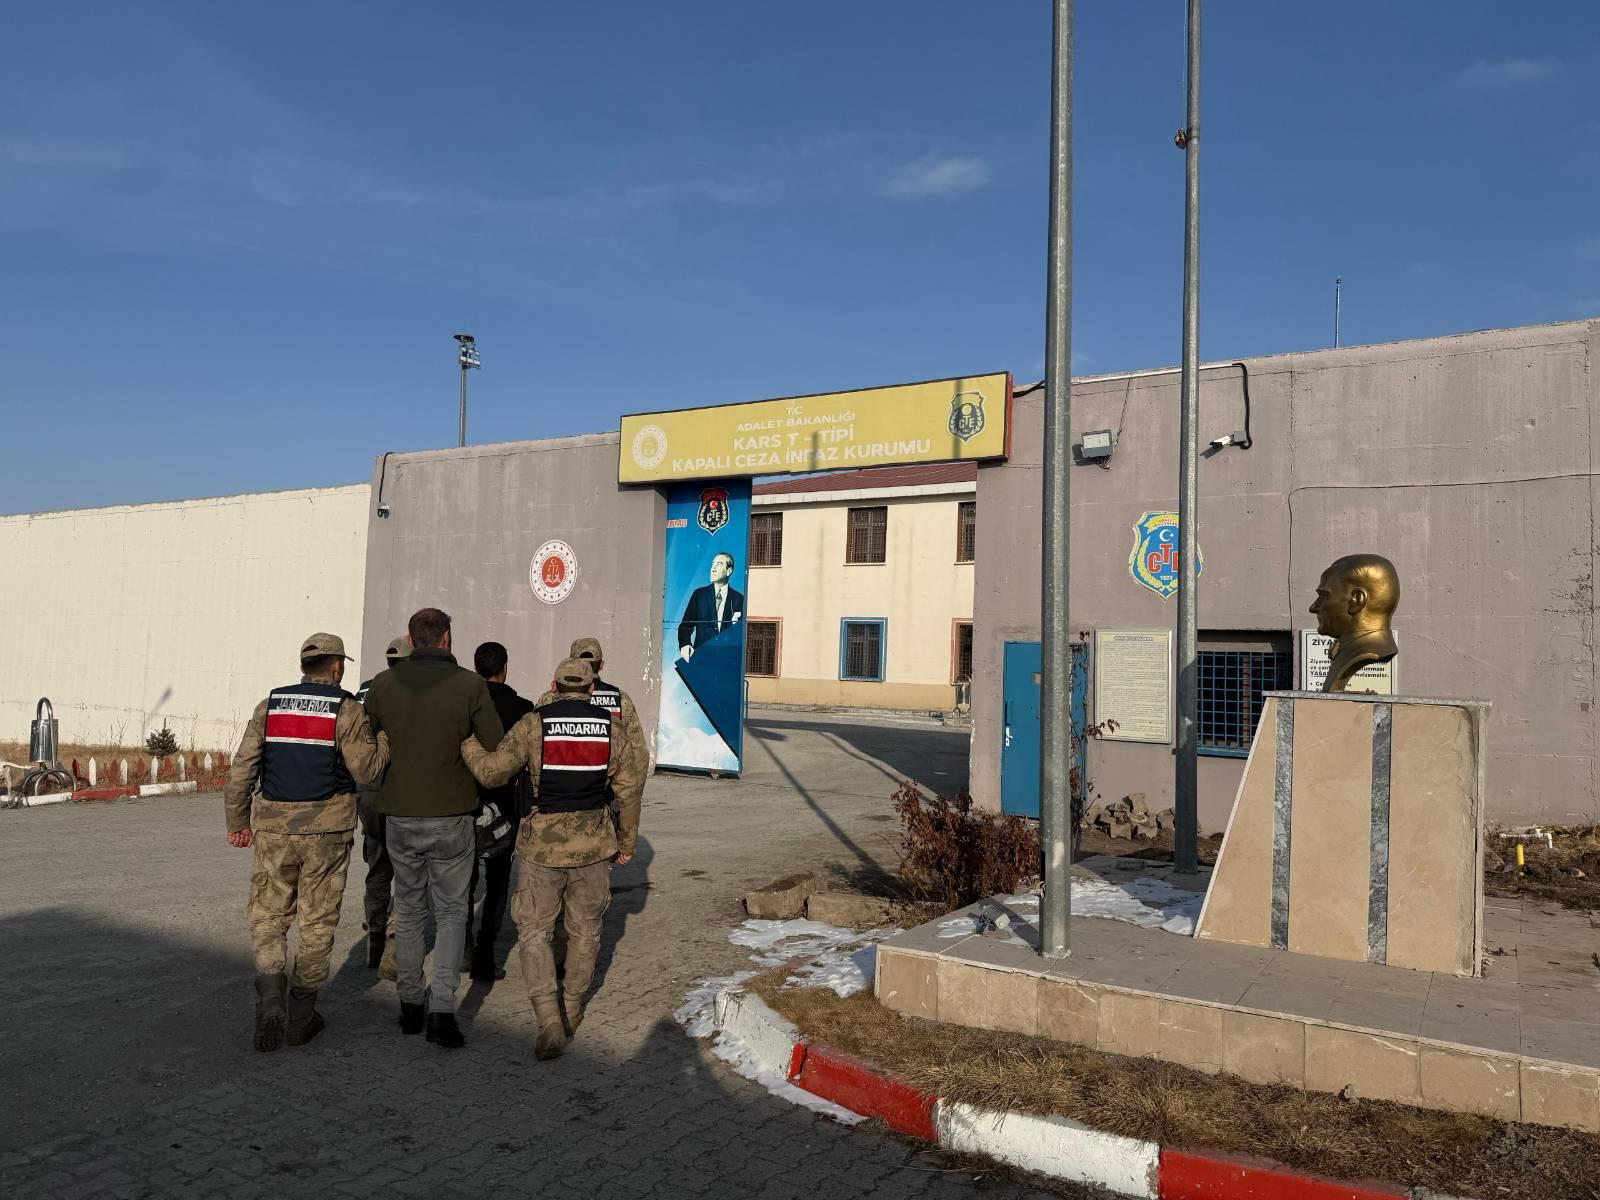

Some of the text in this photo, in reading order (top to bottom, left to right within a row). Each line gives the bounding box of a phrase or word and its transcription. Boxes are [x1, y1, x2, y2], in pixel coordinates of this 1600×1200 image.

[736, 410, 856, 432] ADALET BAKANLIĞI
[959, 415, 975, 429] CTE
[733, 433, 782, 451] KARS
[787, 432, 799, 446] T
[818, 424, 854, 444] TİPİ
[672, 439, 931, 471] KAPALI CEZA İNFAZ KURUMU
[706, 509, 721, 522] CTE
[1312, 637, 1333, 646] ZİYA
[276, 698, 331, 713] JANDARMA
[547, 723, 608, 735] JANDARMA
